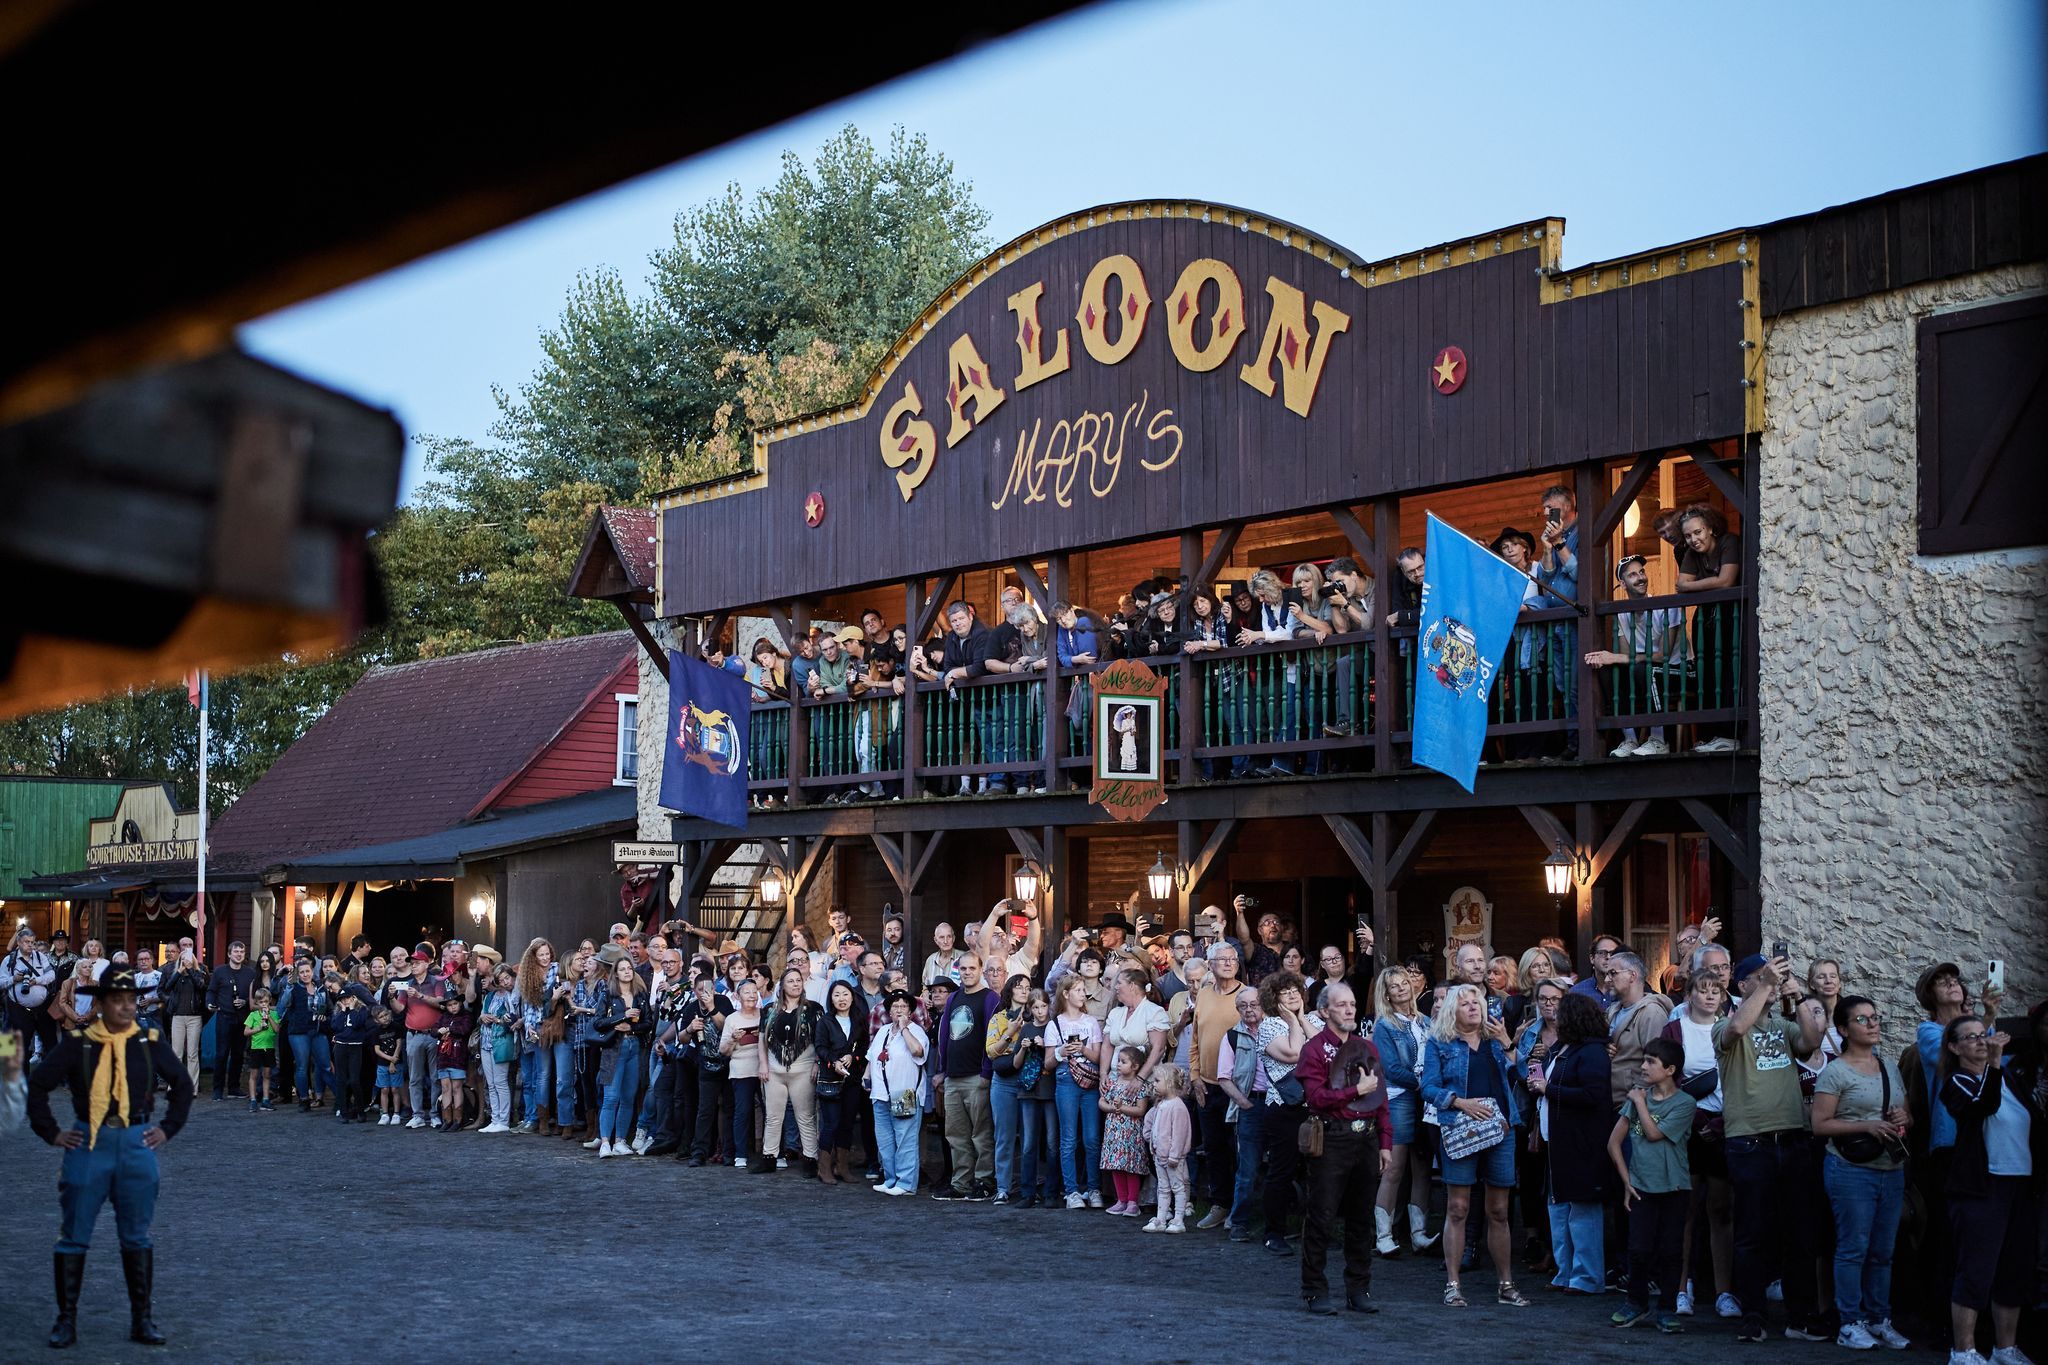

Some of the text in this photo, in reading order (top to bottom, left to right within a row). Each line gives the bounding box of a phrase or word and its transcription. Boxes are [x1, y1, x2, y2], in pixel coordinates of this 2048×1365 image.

[880, 254, 1352, 502] SALOON
[992, 389, 1183, 510] MARY'S
[1096, 781, 1162, 808] Saloon
[648, 847, 675, 857] Saloon
